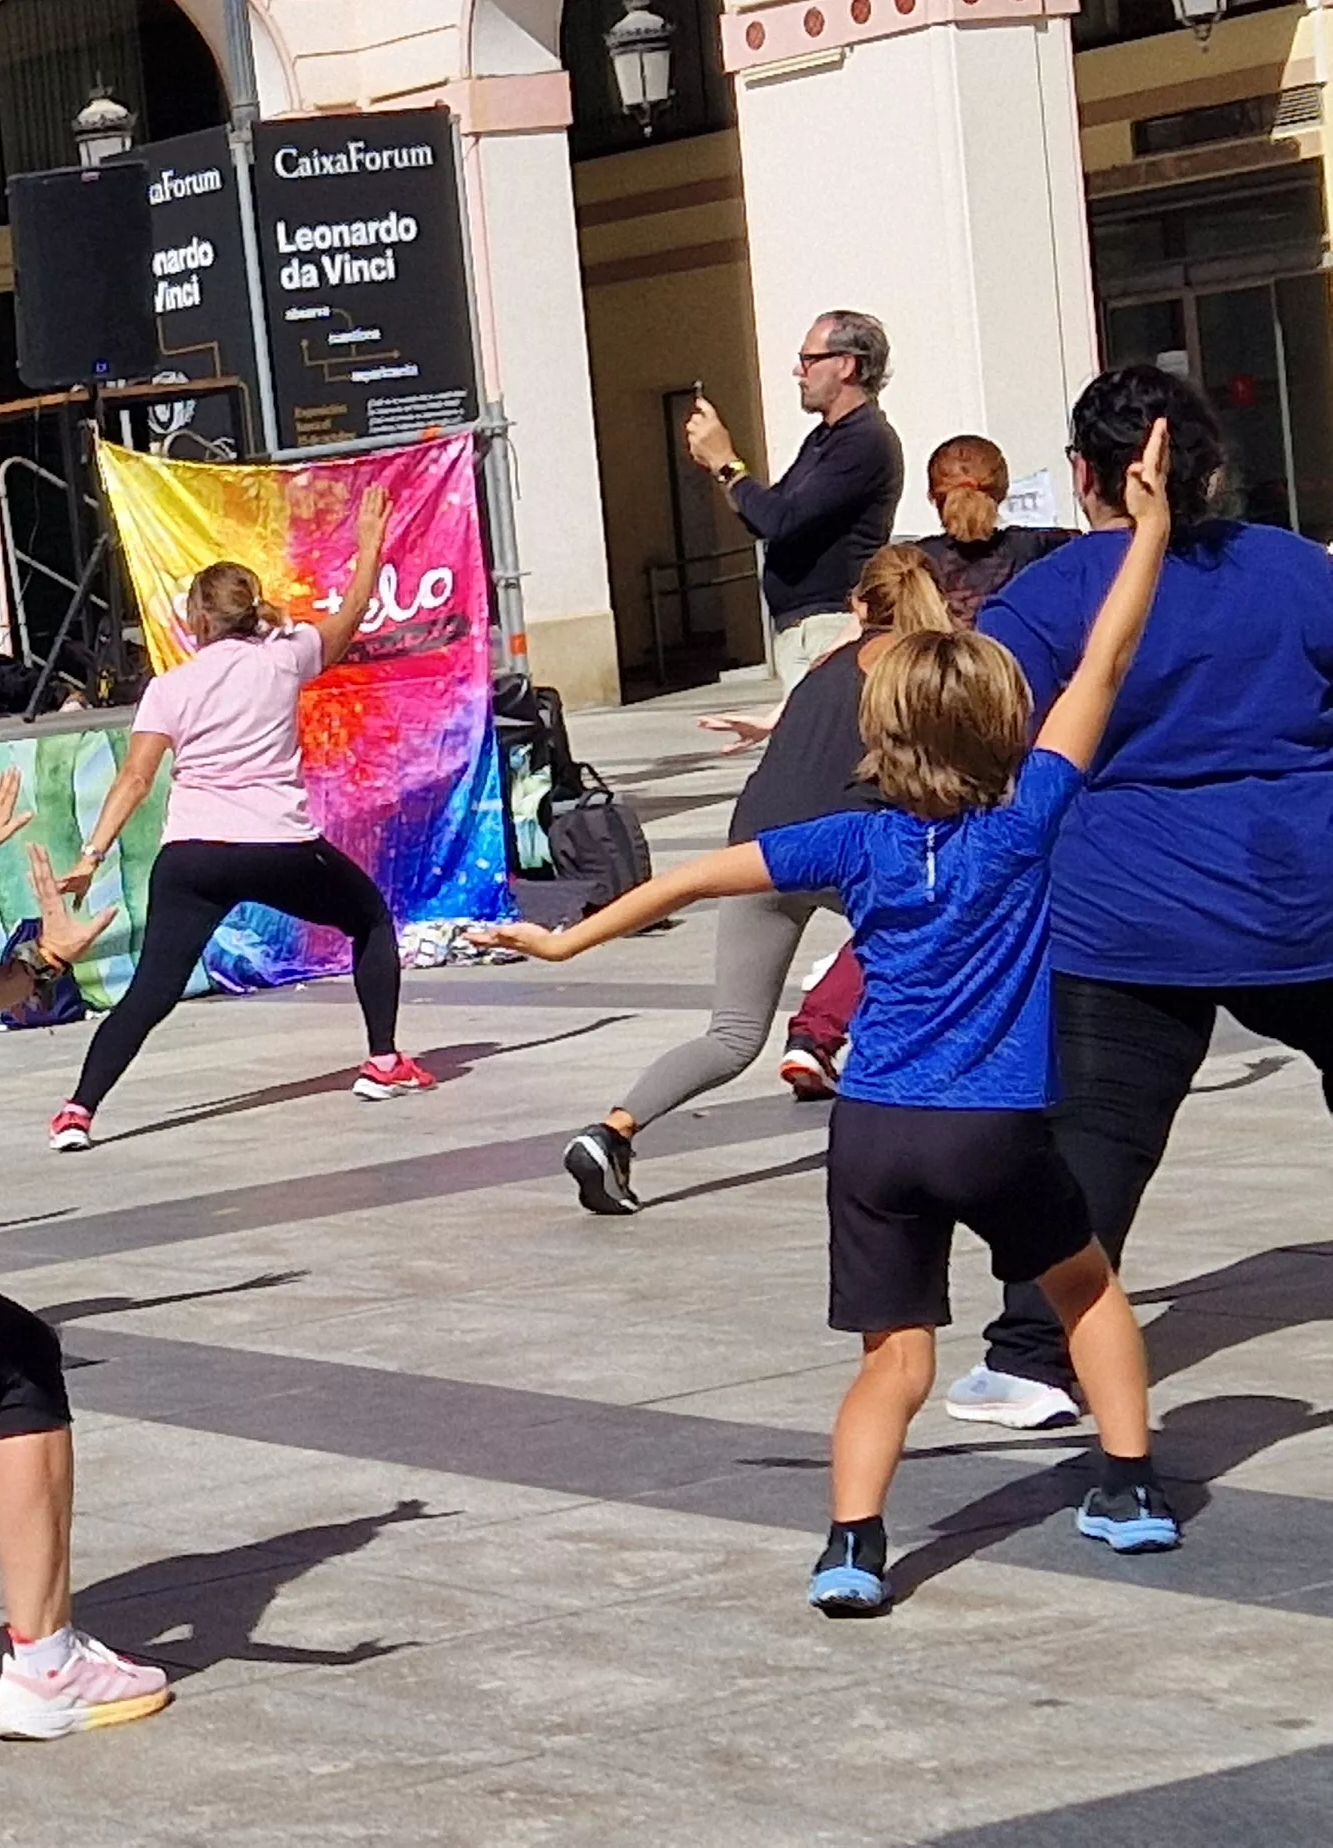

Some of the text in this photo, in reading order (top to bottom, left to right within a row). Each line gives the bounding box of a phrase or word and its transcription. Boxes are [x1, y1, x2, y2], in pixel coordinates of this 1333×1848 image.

[274, 140, 434, 179] CaixaForum
[149, 167, 222, 205] aForum
[276, 210, 418, 254] Leonardo
[152, 236, 215, 277] nardo
[280, 247, 397, 290] da Vinci
